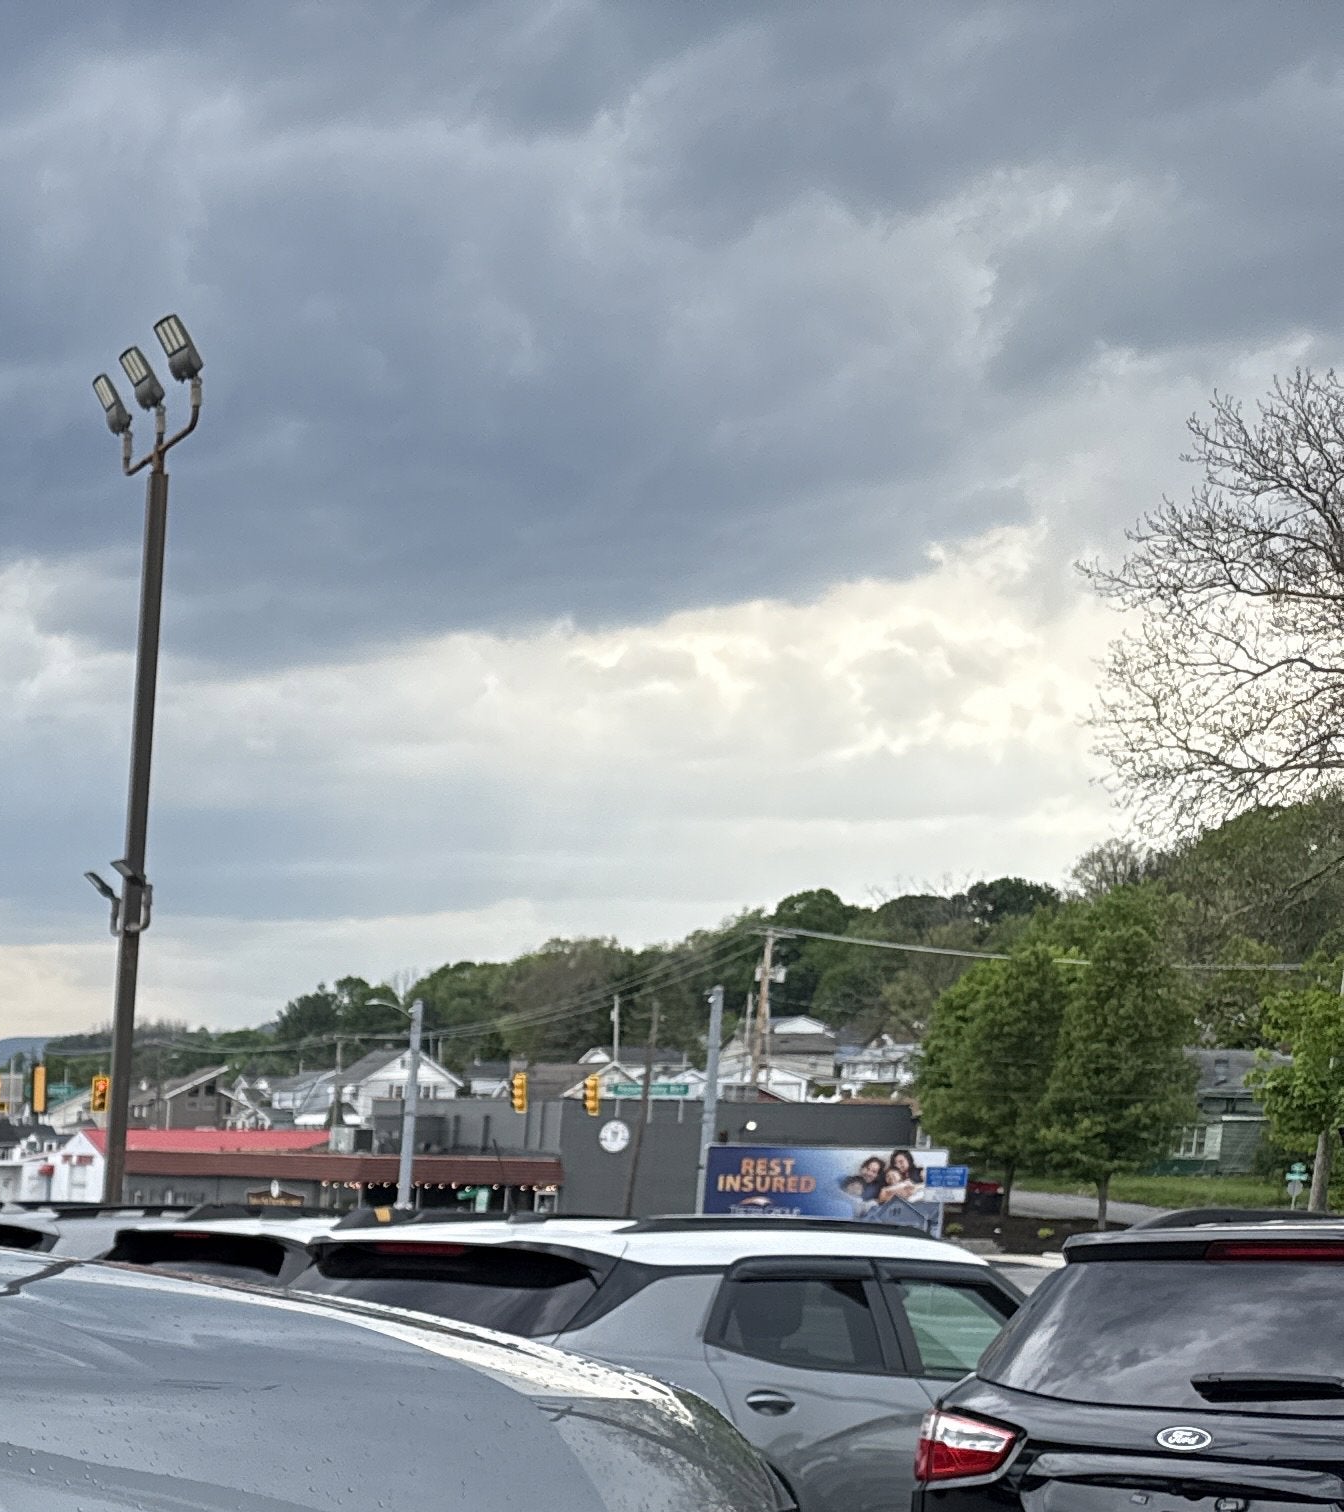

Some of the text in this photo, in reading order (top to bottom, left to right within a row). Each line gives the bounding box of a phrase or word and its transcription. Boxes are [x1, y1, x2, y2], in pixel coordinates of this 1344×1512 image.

[741, 1157, 796, 1176] REST
[717, 1174, 817, 1194] INSURED
[1167, 1430, 1200, 1445] Ford
